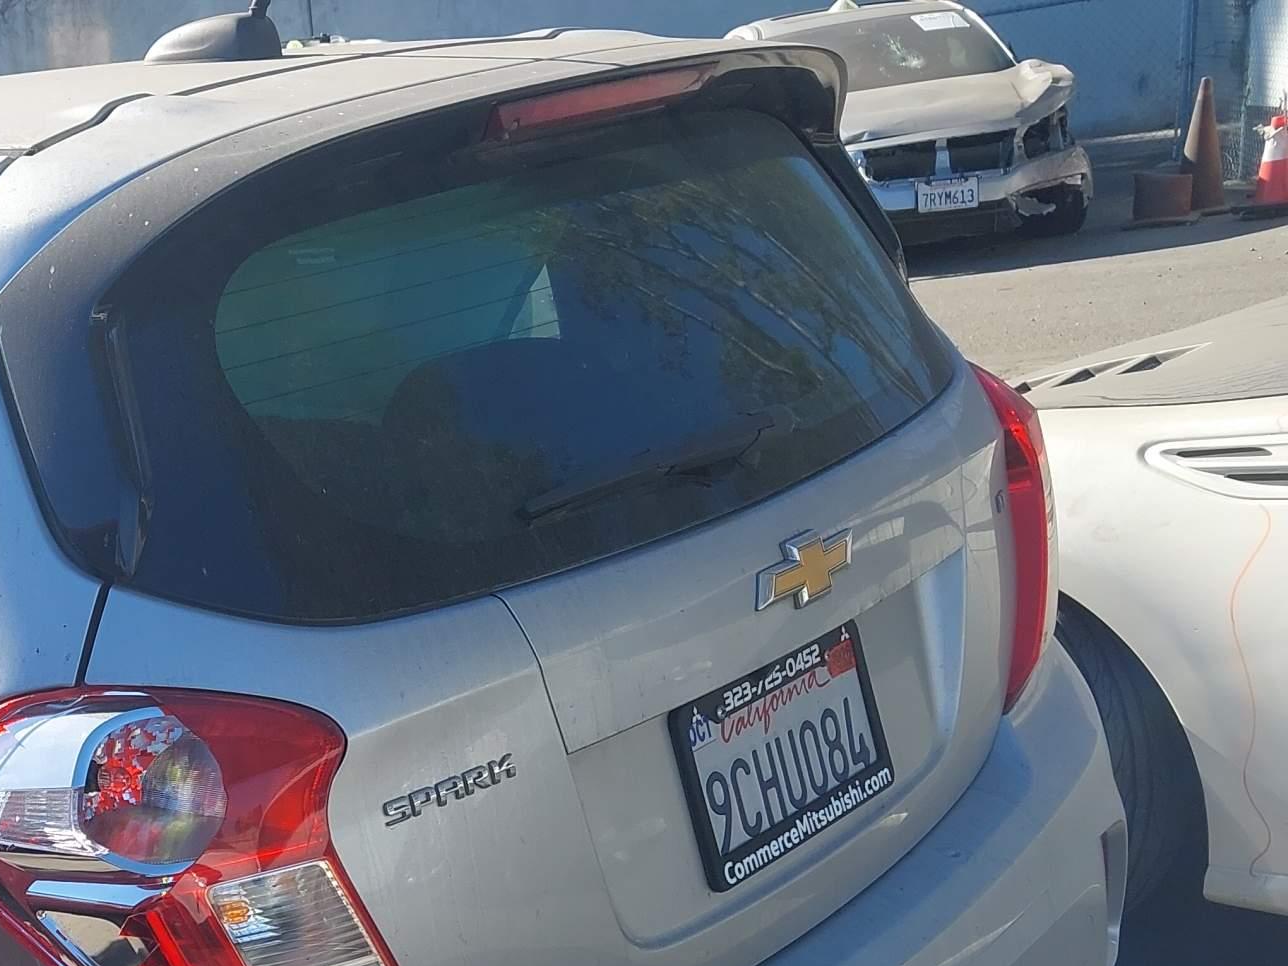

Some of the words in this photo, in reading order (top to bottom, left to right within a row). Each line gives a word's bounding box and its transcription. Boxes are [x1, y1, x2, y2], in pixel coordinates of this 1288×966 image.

[921, 188, 975, 209] 7RYM613
[720, 670, 831, 744] California
[382, 752, 517, 828] SPARK
[705, 696, 870, 857] 9CHU084
[723, 766, 893, 885] CommerceMitsubishi.com
